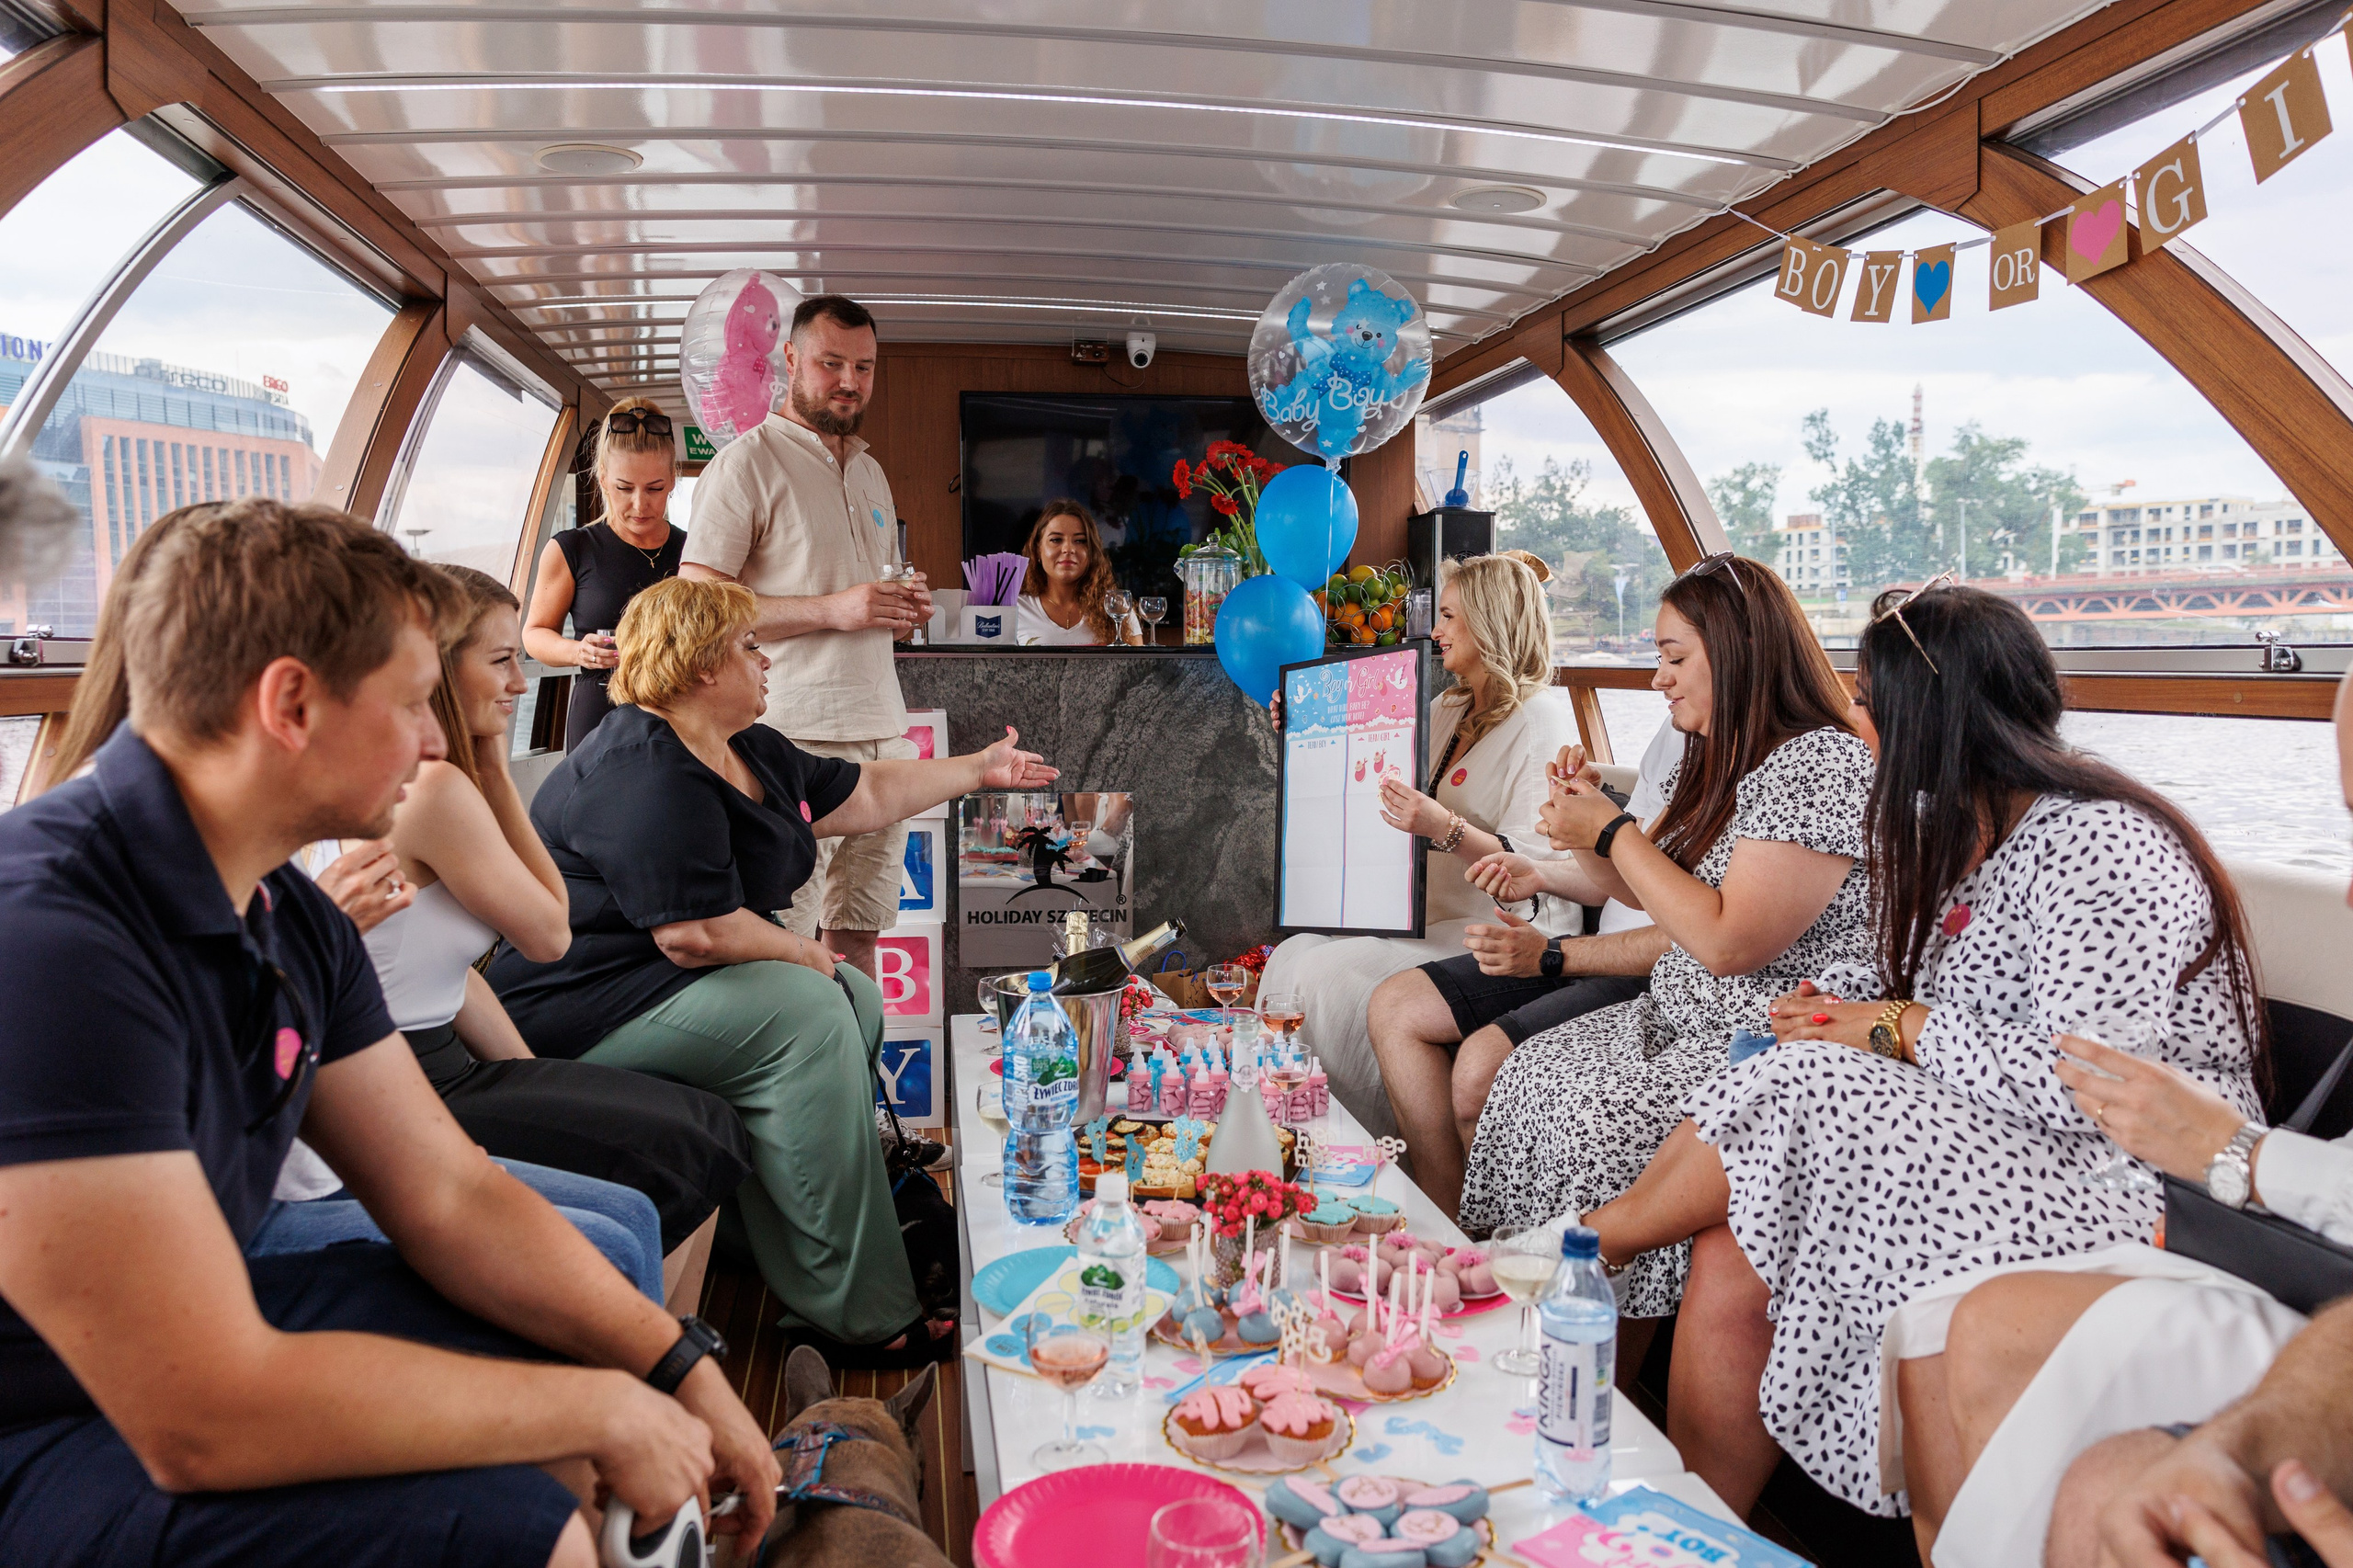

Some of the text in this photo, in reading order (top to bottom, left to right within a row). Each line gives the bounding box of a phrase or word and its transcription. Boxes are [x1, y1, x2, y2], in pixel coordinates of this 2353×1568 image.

[1780, 80, 2305, 316] BOY OR GI
[1, 335, 52, 360] ION
[1260, 370, 1386, 433] Baby Boy
[689, 447, 716, 456] EWA
[691, 434, 708, 445] W
[1319, 668, 1344, 704] Boy
[1357, 665, 1380, 699] Girl
[967, 910, 1128, 925] HOLIDAY SZECIN
[1538, 1344, 1551, 1429] KINGA
[1654, 1529, 1731, 1563] BOY
